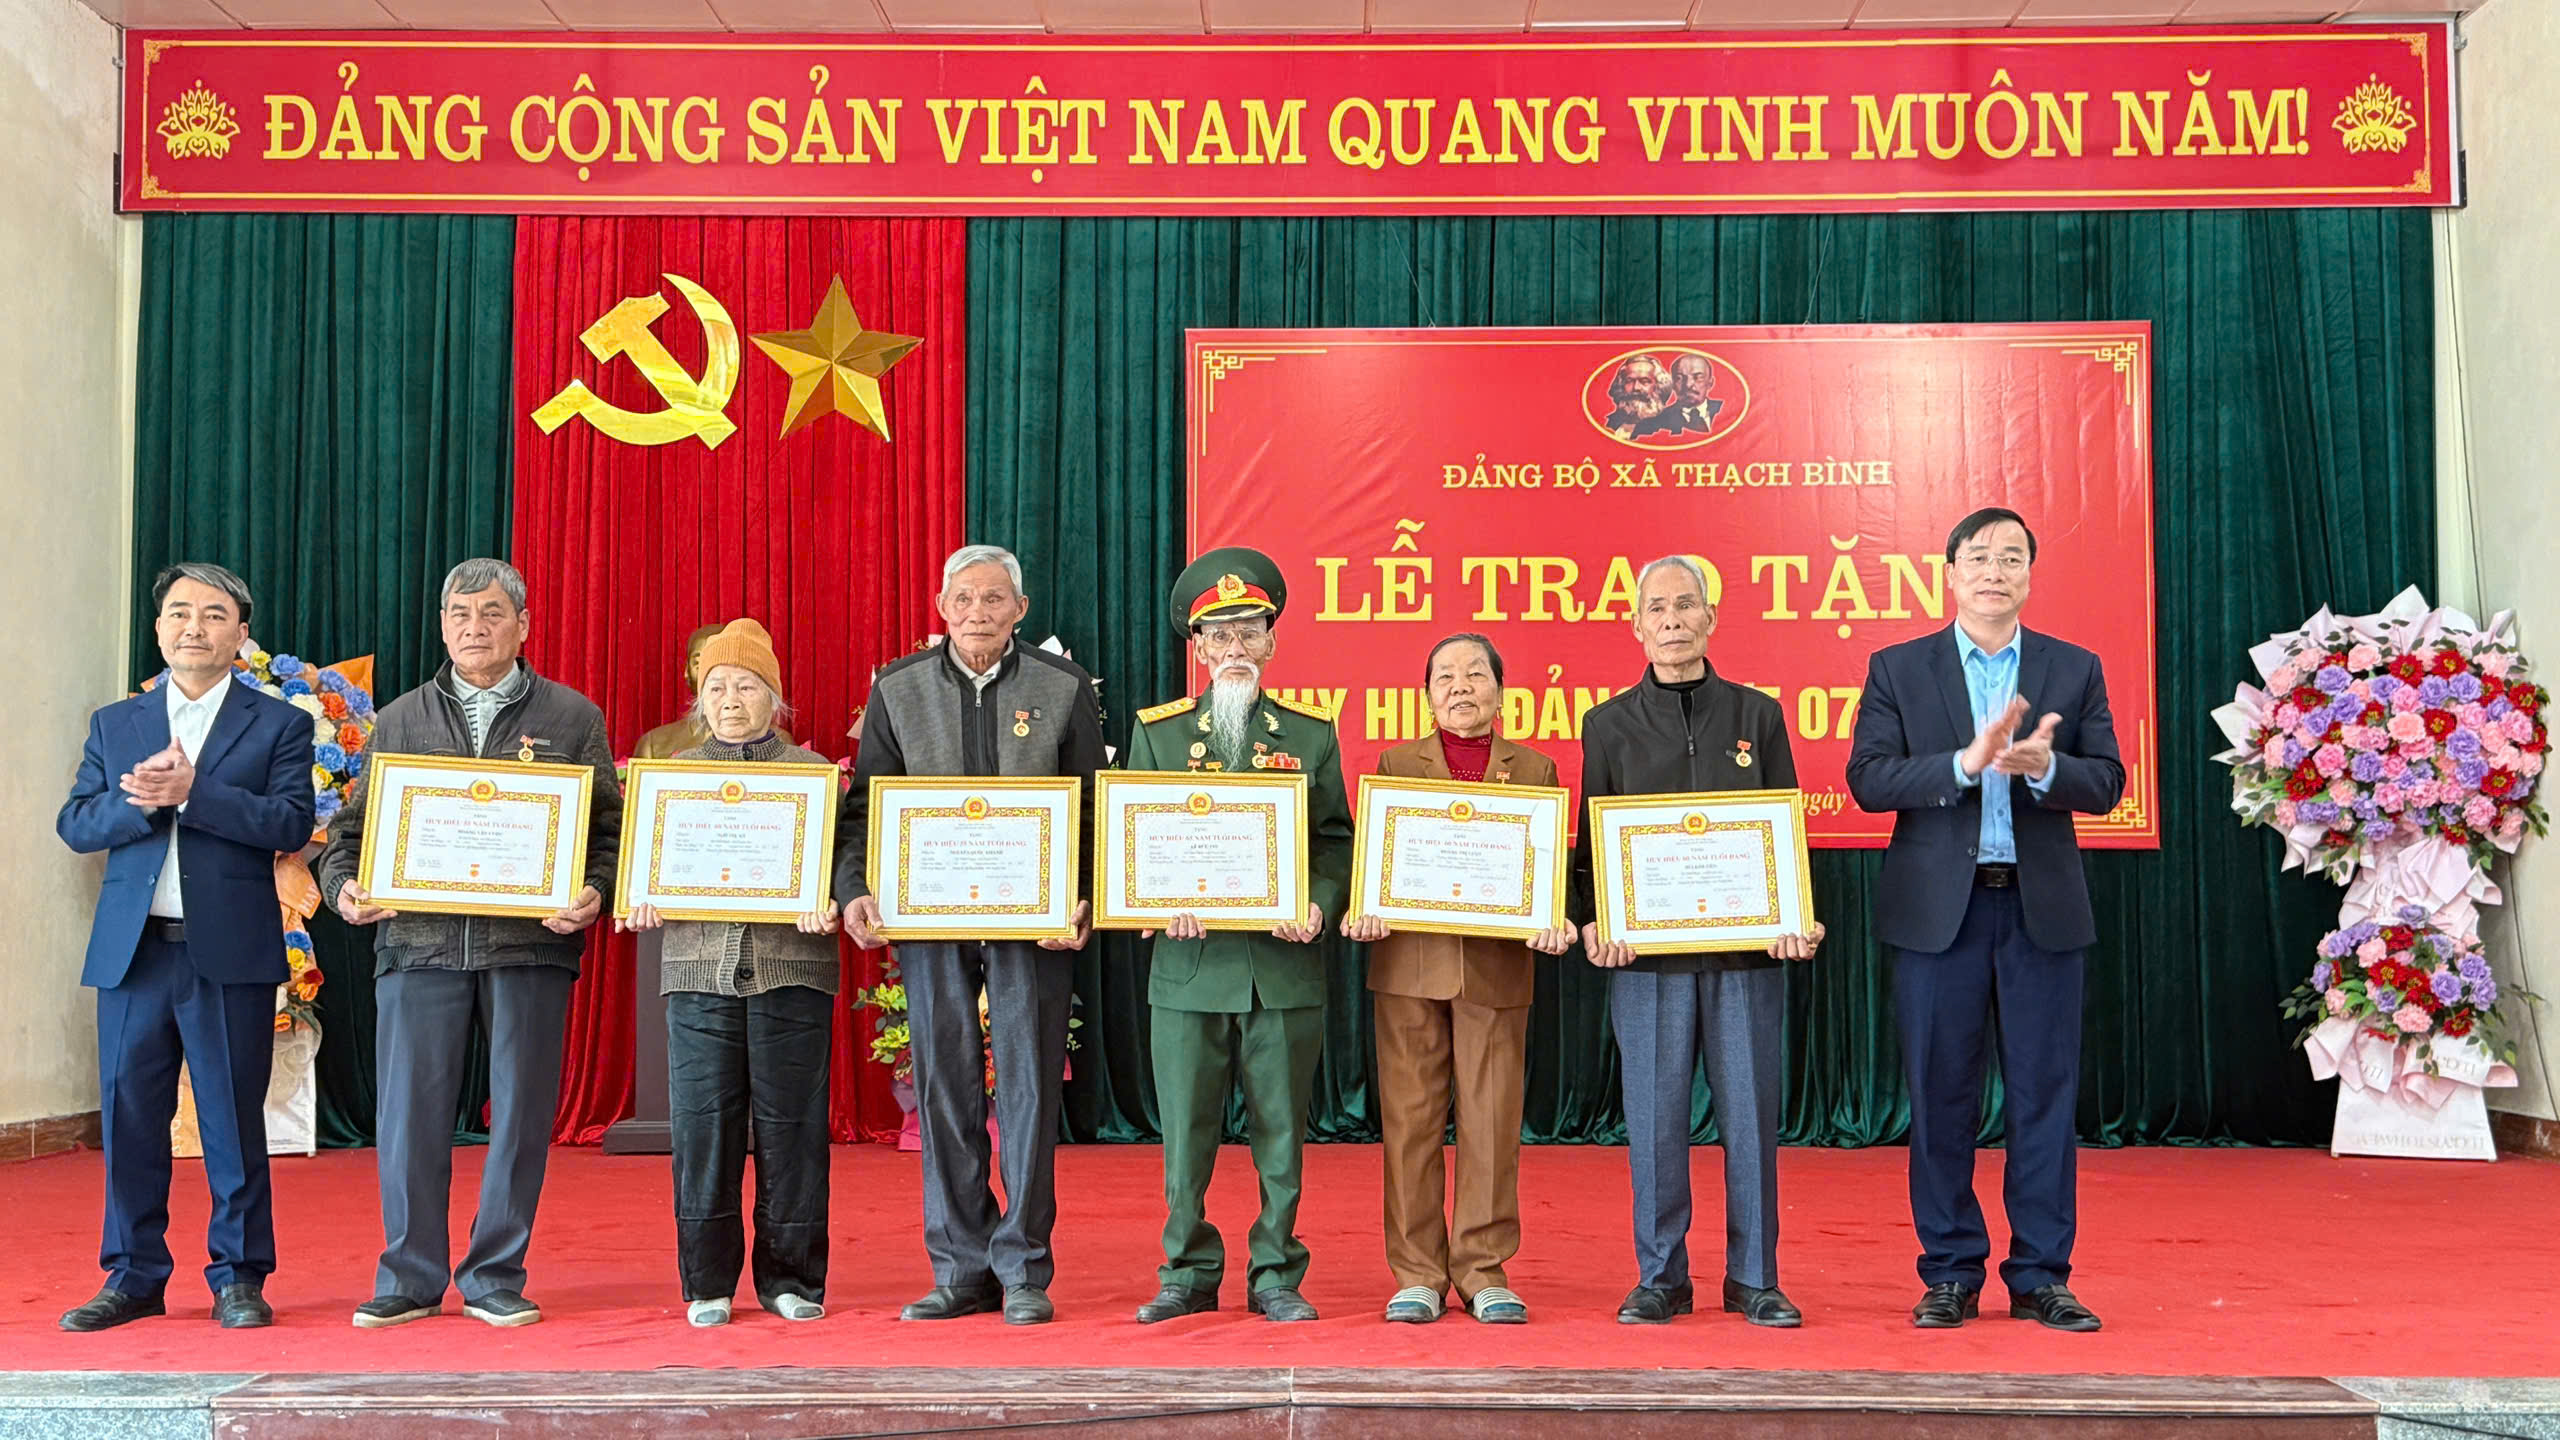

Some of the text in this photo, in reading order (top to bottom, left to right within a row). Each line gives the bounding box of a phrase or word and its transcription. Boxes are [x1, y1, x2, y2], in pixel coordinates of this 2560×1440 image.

[263, 61, 2310, 184] ĐẢNG CỘNG SẢN VIỆT NAM QUANG VINH MUÔN NĂM!
[1442, 453, 1892, 494] ĐẢNG BỘ XÃ THẠCH BÌNH
[1315, 518, 1433, 622] LỄ
[1751, 534, 1948, 639] TẶN
